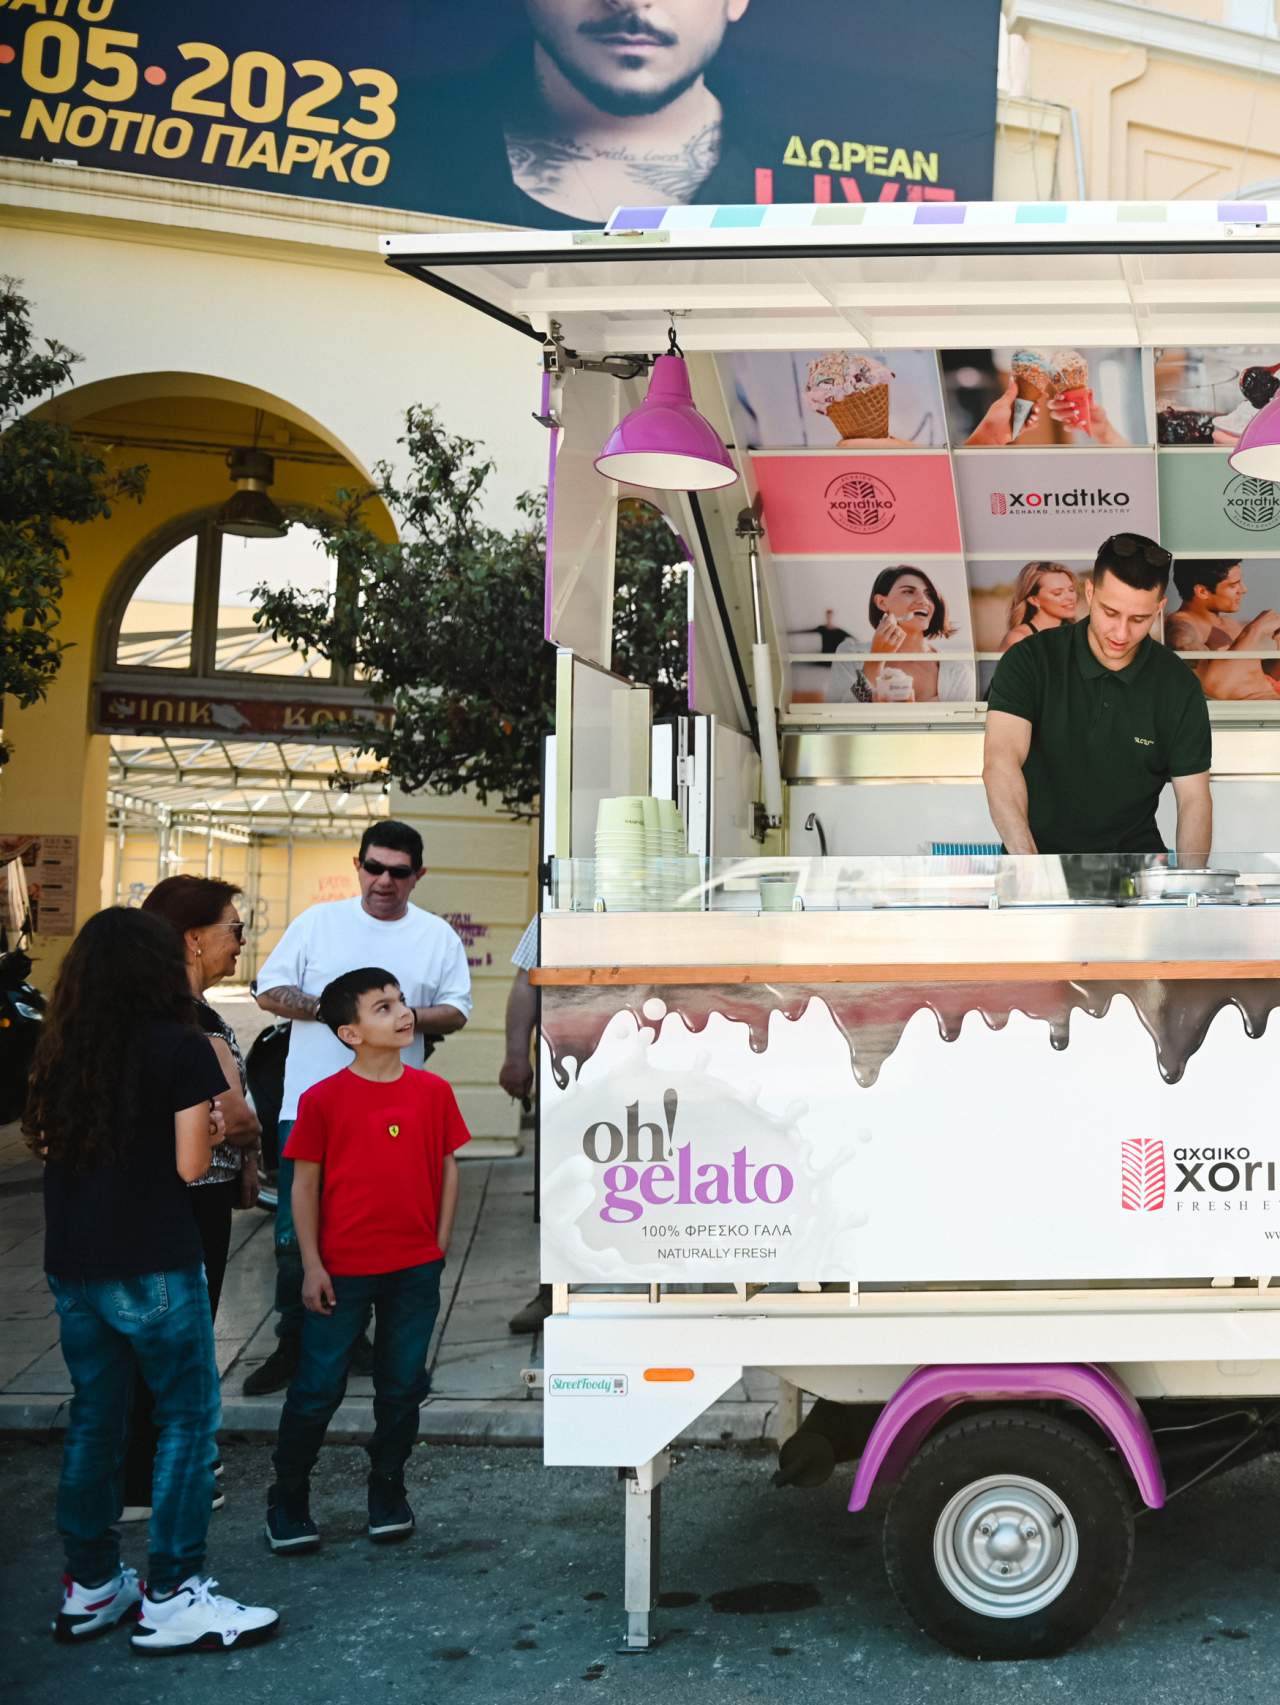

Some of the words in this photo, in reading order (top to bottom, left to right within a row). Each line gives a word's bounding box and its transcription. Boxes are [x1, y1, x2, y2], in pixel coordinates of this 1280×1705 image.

[20, 98, 195, 160] ΝΟΤΙΟ
[200, 131, 391, 187] ΠΑΡΚΟ
[783, 135, 938, 183] ΔΩΡΕΑΝ
[582, 1088, 678, 1163] oh!
[599, 1141, 794, 1223] gelato
[1176, 1199, 1249, 1212] FRESH
[641, 1224, 681, 1237] 100%
[684, 1224, 749, 1237] ΦΡΕΣΚΟ
[753, 1223, 792, 1237] ΓΑΛΑ
[657, 1248, 730, 1260] NATURALLY
[733, 1247, 777, 1259] FRESH
